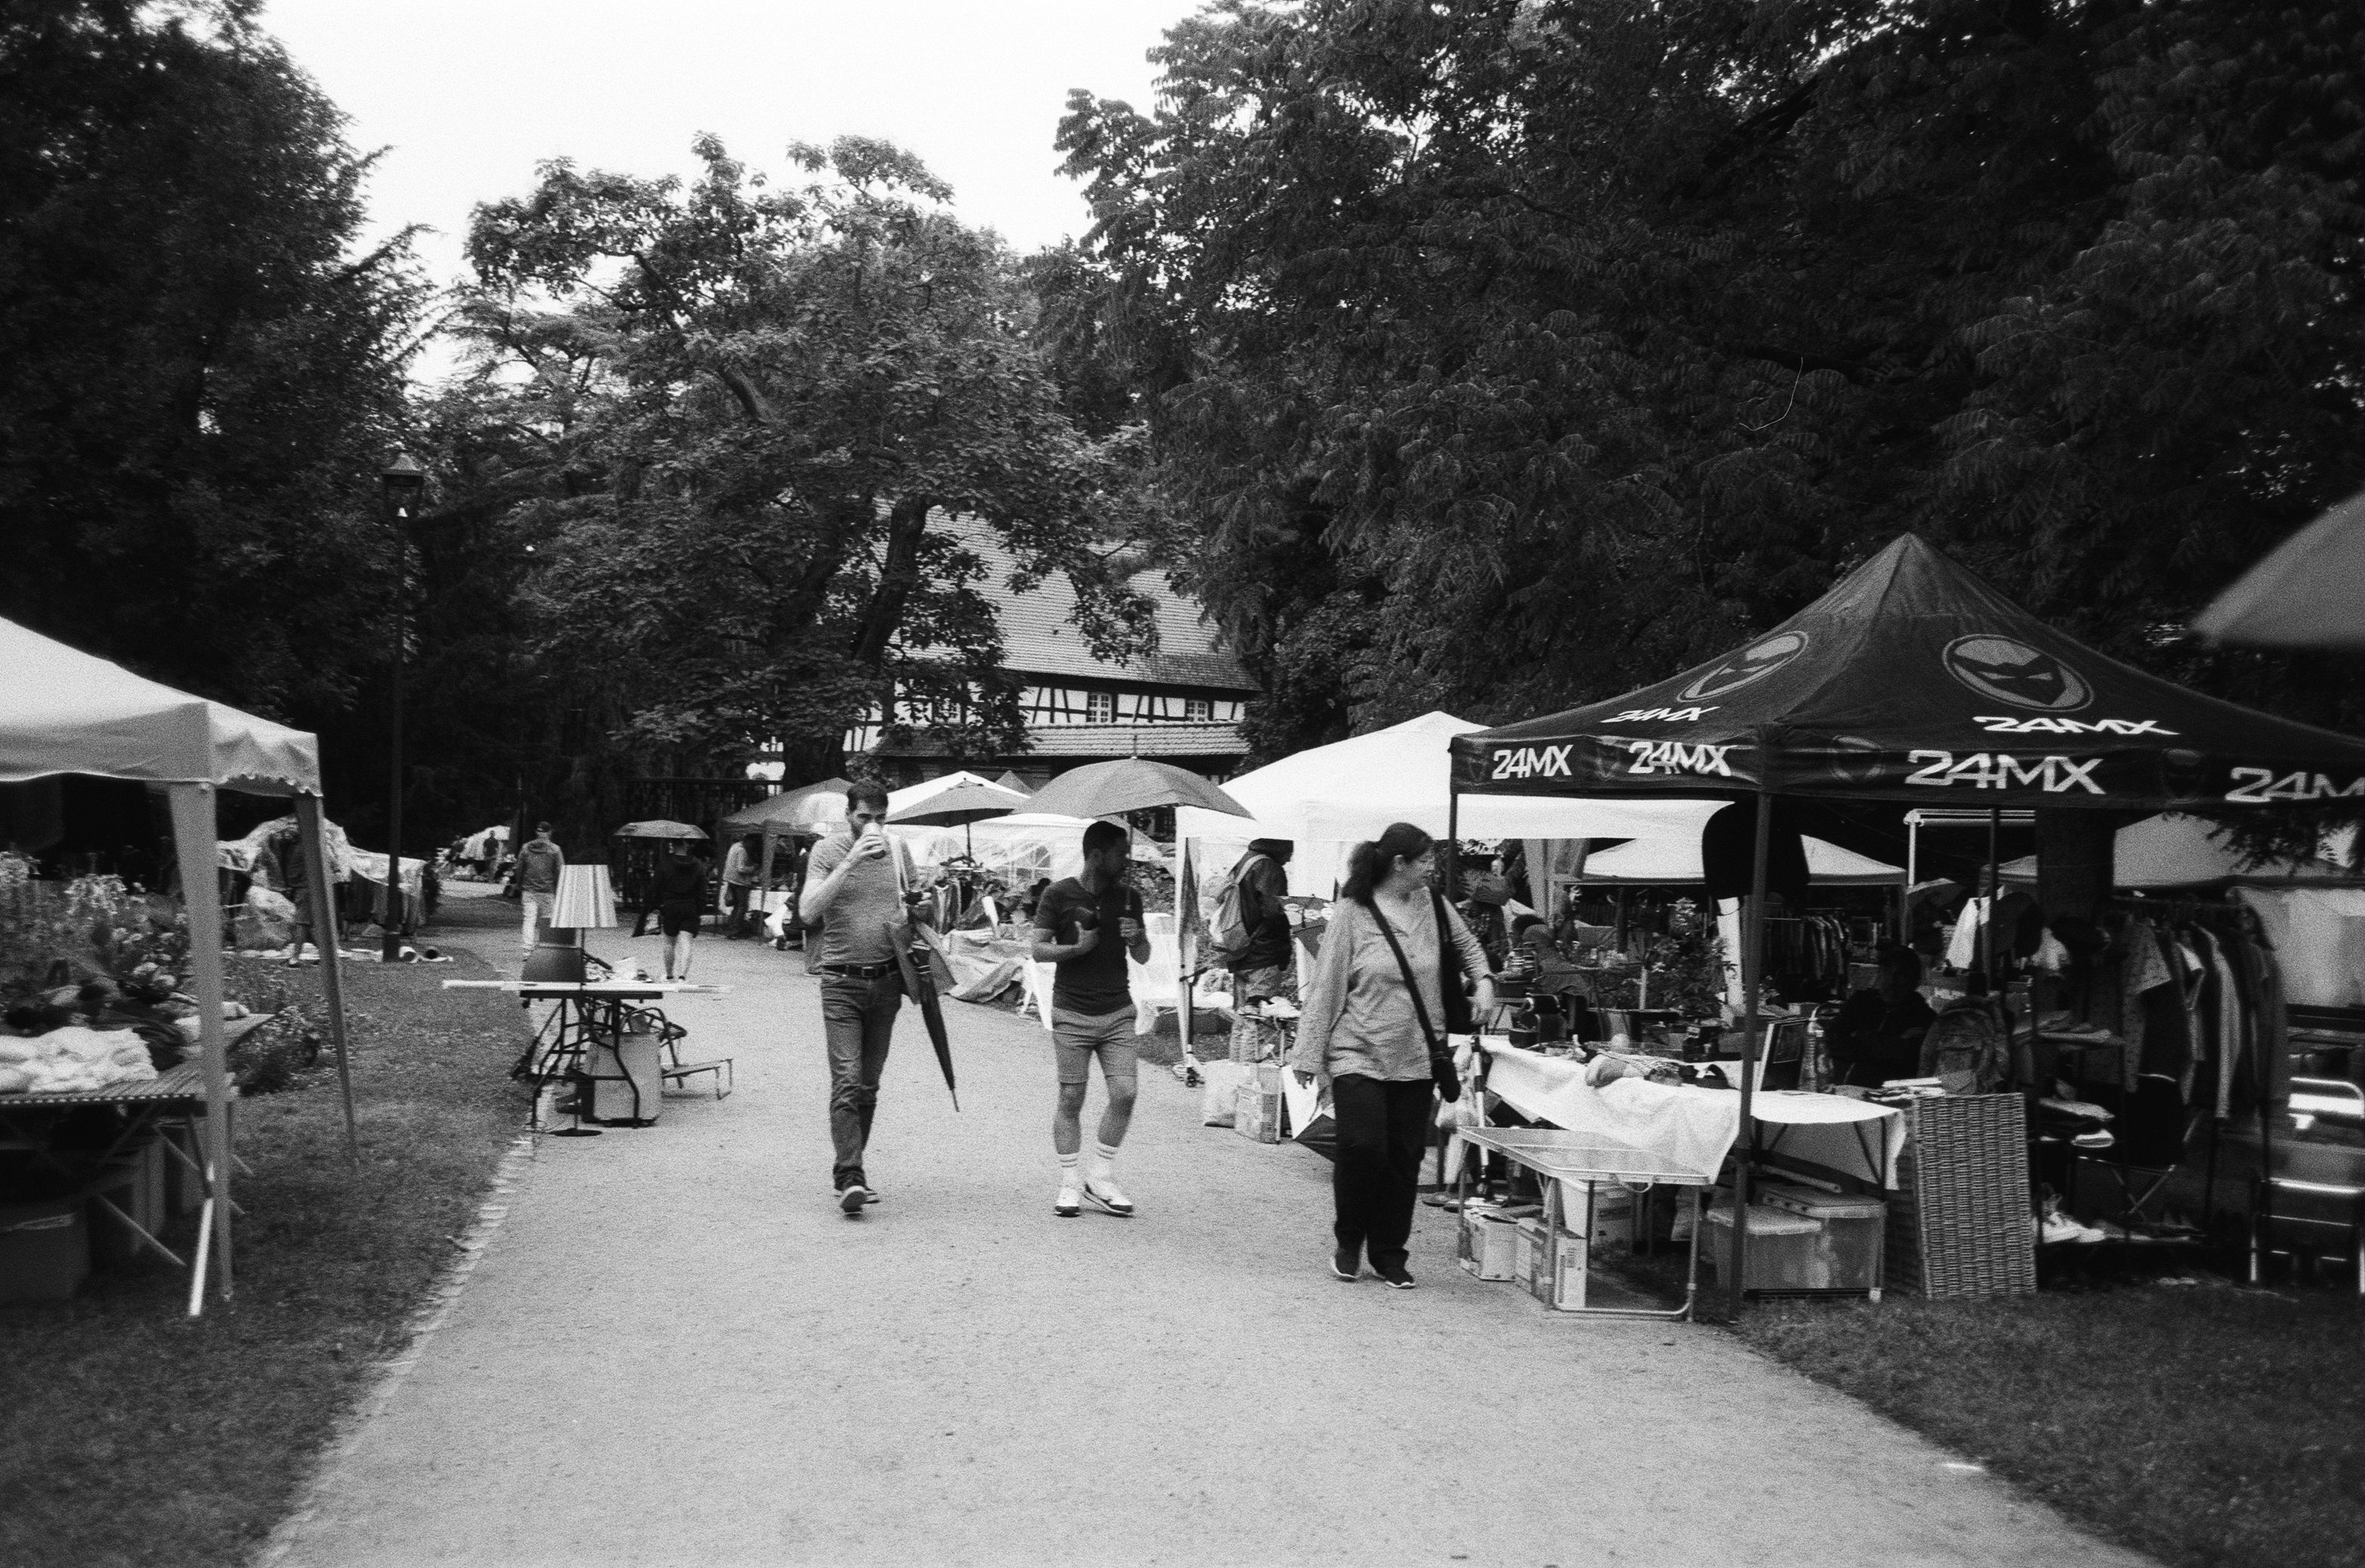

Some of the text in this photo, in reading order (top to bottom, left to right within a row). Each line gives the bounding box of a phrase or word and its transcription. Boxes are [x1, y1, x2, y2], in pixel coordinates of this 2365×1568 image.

[1973, 716, 2181, 735] 24MX
[1492, 744, 1574, 780] 24MX
[1628, 741, 1734, 777] 24MX
[1905, 750, 2107, 794] 24MX
[2224, 767, 2365, 803] 24M
